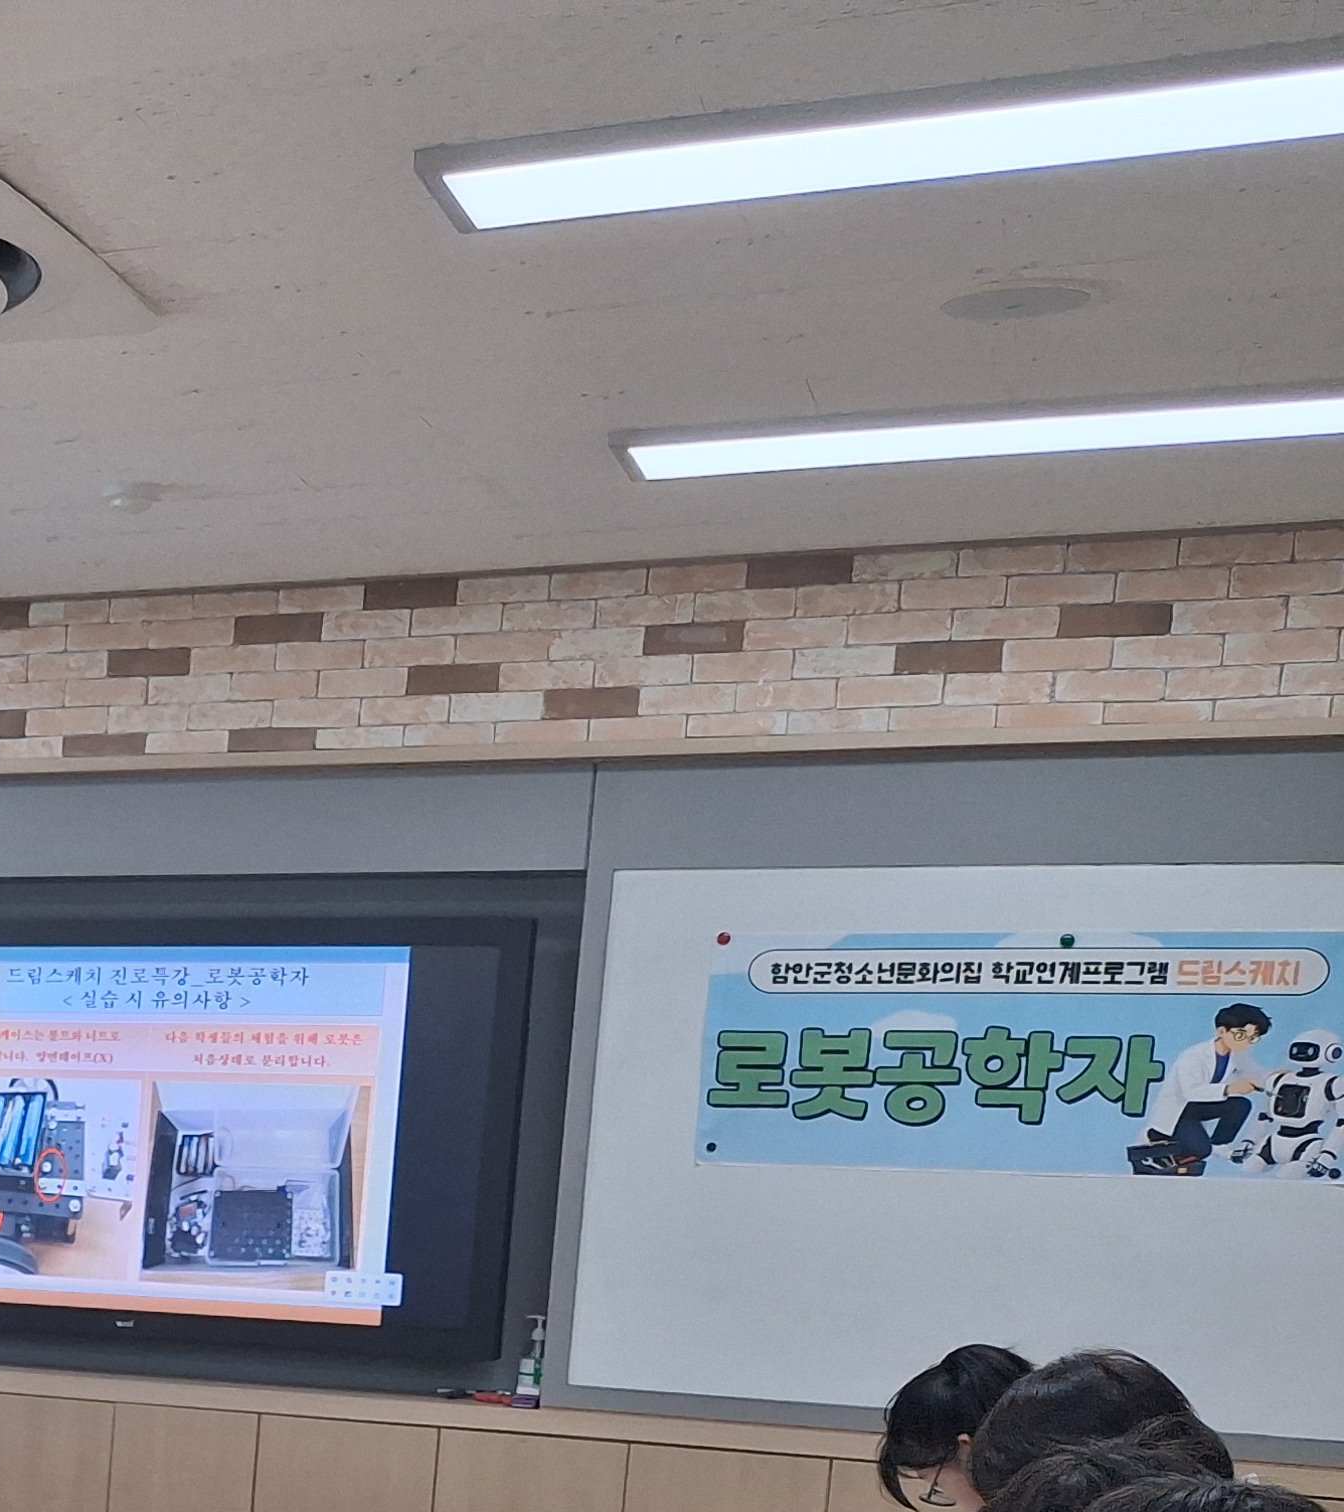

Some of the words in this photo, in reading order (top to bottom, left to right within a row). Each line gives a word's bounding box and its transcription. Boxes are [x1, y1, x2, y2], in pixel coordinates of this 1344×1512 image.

[5, 966, 103, 986] 드림스케치
[109, 966, 310, 988] 진로특강_로봇공학자
[770, 961, 983, 986] 함안군청소년문화의집
[990, 961, 1169, 987] 학교연계프로그램
[1175, 960, 1302, 988] 드림스케치
[78, 990, 116, 1010] 실습
[124, 990, 143, 1010] 시
[150, 990, 232, 1011] 유의사항
[164, 1031, 189, 1044] 다음
[706, 1025, 1165, 1126] 로봇공학자
